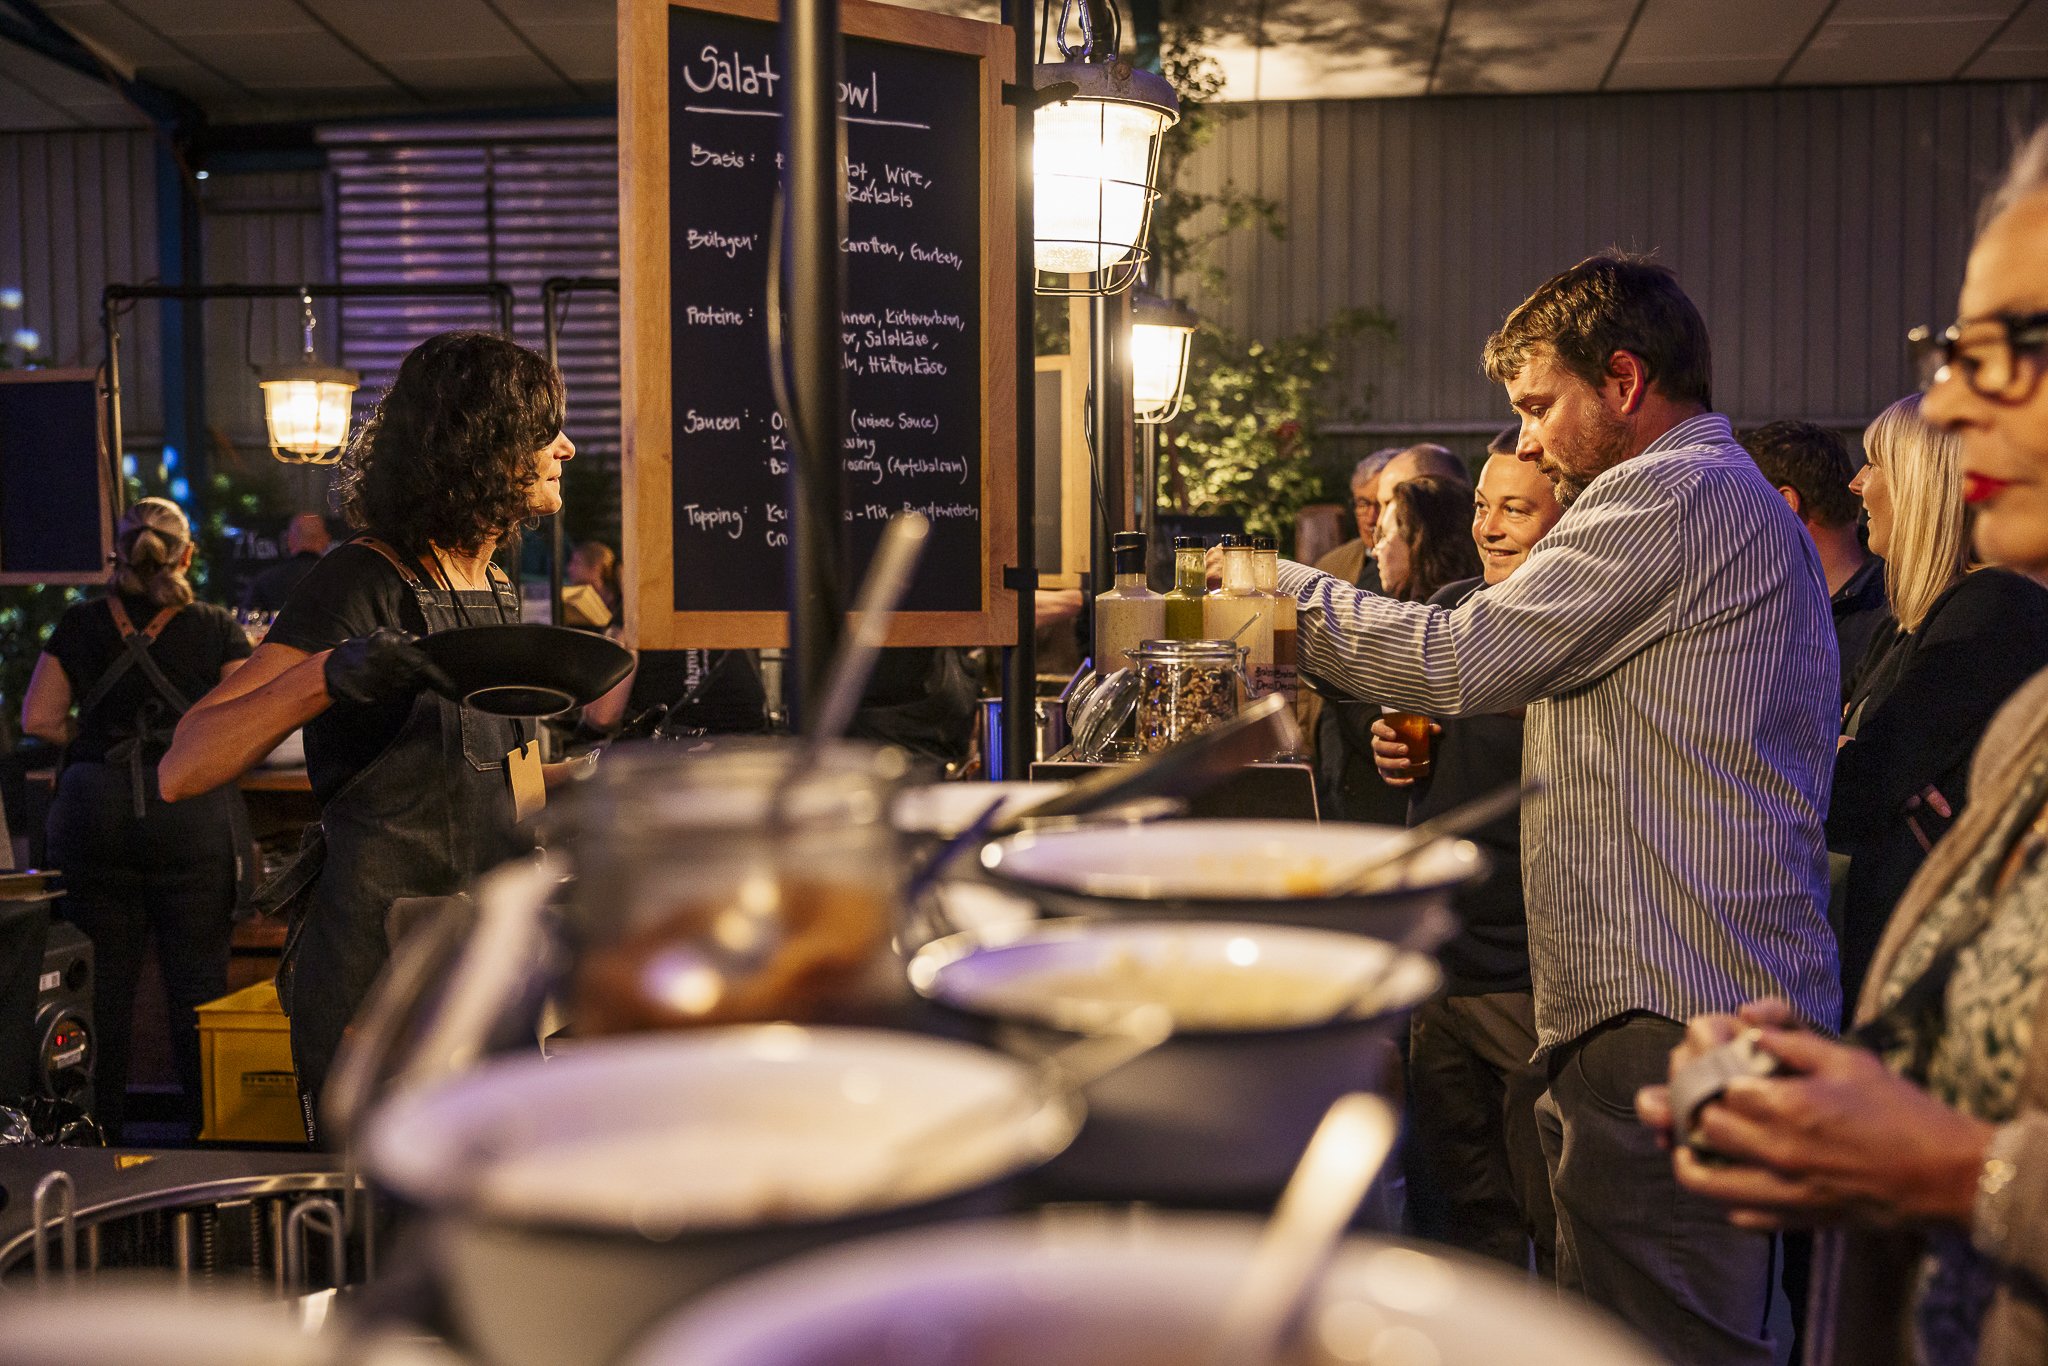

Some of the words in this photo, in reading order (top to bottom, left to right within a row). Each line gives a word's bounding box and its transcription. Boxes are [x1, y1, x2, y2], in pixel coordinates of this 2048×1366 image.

[683, 45, 780, 98] Salat
[837, 71, 878, 114] owl
[845, 181, 913, 208] Rotkabis
[910, 243, 962, 271] Gurken,
[868, 353, 947, 376] Hüttenkäse
